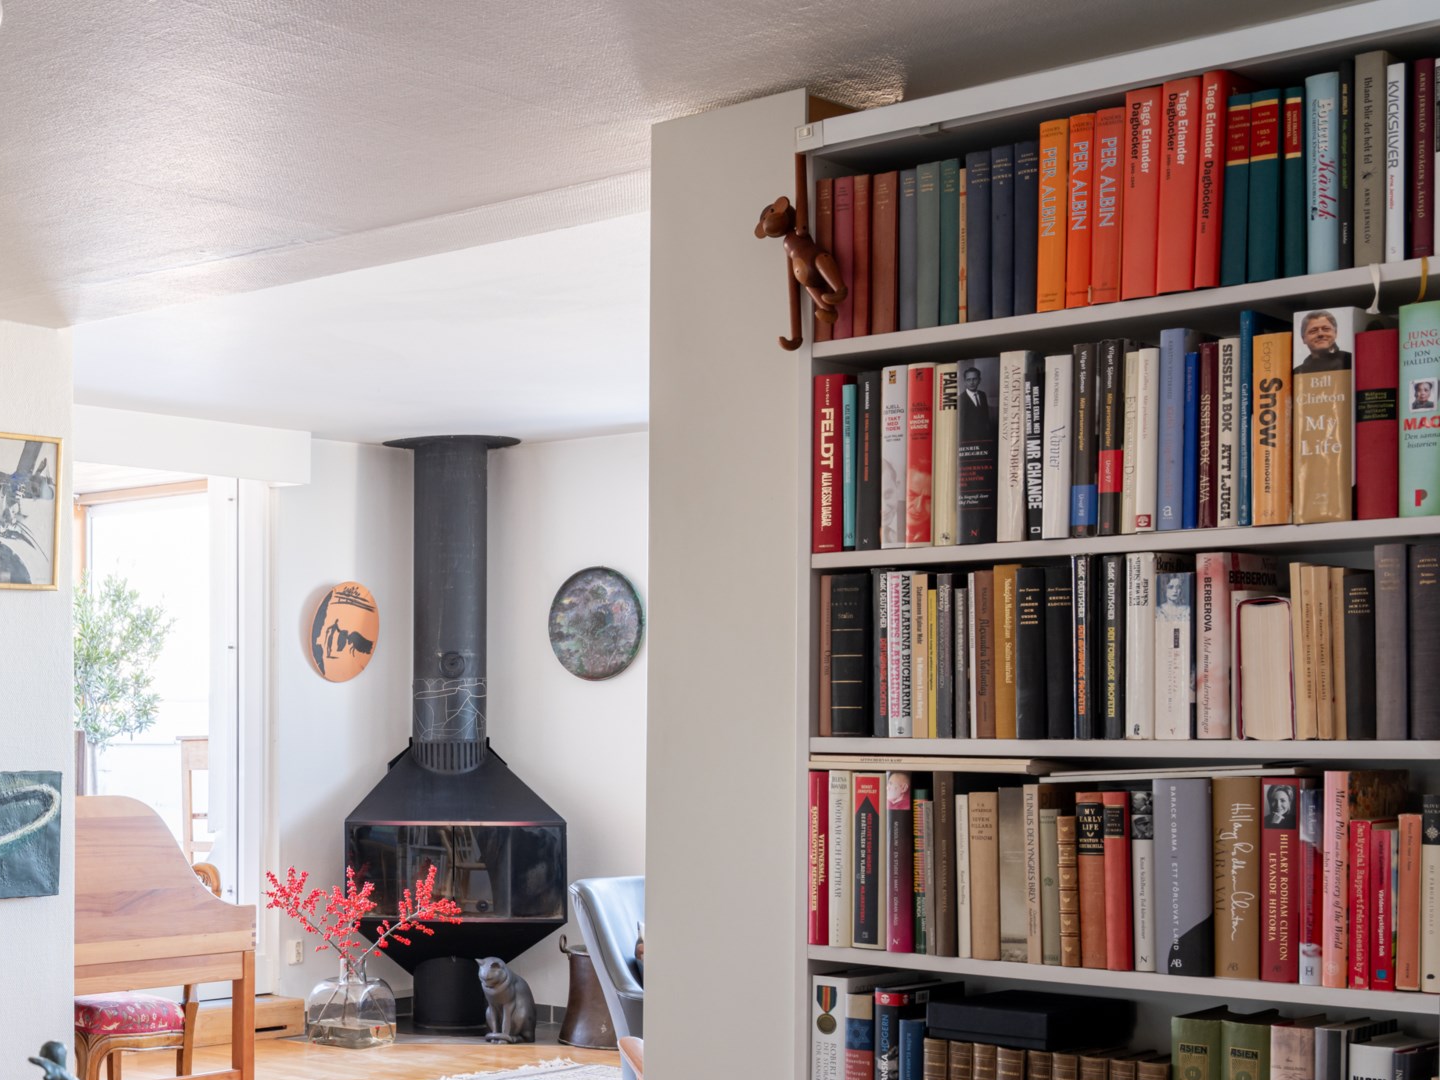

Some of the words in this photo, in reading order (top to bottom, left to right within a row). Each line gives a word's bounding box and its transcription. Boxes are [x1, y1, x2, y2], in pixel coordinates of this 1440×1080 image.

[1177, 91, 1189, 117] Tage
[1206, 84, 1217, 110] Tage
[1363, 78, 1373, 104] Ibland
[1129, 102, 1142, 160] Dagböcker
[1141, 100, 1153, 126] Tage
[1166, 93, 1179, 151] Dagböcker
[1363, 106, 1373, 120] blir
[1387, 81, 1399, 169] KVICKSILVER
[1101, 137, 1117, 171] PER
[1141, 128, 1152, 173] Erlander
[1176, 119, 1188, 165] Erlander
[1204, 113, 1216, 158] Erlander
[1042, 147, 1057, 181] PER
[1073, 141, 1089, 175] PER
[1072, 179, 1087, 230] ALBIN
[1099, 175, 1115, 227] ALBIN
[1201, 161, 1214, 219] Dagböcker
[1317, 155, 1337, 221] Kärlek
[1041, 185, 1056, 236] ALBIN
[1408, 329, 1438, 341] JUNG
[1078, 351, 1087, 370] Vilgot
[1106, 346, 1115, 365] Vilgot
[1221, 344, 1233, 400] SISSELA
[1262, 341, 1273, 373] Edgar
[942, 372, 958, 411] PALME
[1010, 364, 1020, 411] AUGUST
[1078, 371, 1086, 393] Sjöman
[1105, 366, 1114, 388] Sjöman
[1311, 375, 1331, 388] Bill
[1200, 394, 1210, 440] SISSELA
[1260, 377, 1283, 448] Snow
[1296, 392, 1345, 405] Clinton
[1221, 403, 1232, 433] BOK
[1305, 415, 1337, 439] My
[1403, 415, 1440, 431] MAO
[821, 408, 834, 468] FELDT
[1009, 412, 1020, 489] STRINDBERG
[1026, 440, 1042, 459] MR
[1049, 425, 1066, 471] Vänner
[1200, 441, 1210, 466] BOK
[1301, 439, 1342, 456] Life
[1220, 444, 1231, 472] ATT
[1263, 450, 1272, 494] memoarer
[1026, 462, 1042, 510] CHANCE
[1200, 475, 1209, 504] ALVA
[1220, 475, 1231, 521] LJUGA
[902, 575, 911, 606] ANNA
[1077, 580, 1085, 618] DEUTSCHER
[1107, 582, 1115, 620] DEUTSCHER
[1203, 577, 1212, 633] BERBEROVA
[891, 582, 900, 638] MINNETS
[902, 609, 910, 650] LARINA
[891, 642, 900, 718] LABYRINTER
[902, 654, 911, 718] BUCHARINA
[1201, 674, 1211, 734] understrykningar
[834, 799, 843, 835] MÖDRAR
[1025, 793, 1034, 825] PLINIUS
[1079, 815, 1103, 823] EARLY
[1220, 803, 1255, 840] Hillary
[1335, 788, 1345, 818] Marco
[1026, 828, 1035, 846] DEN
[1082, 823, 1099, 831] LIFE
[1334, 820, 1345, 840] Polo
[1026, 848, 1035, 882] YNGRES
[1279, 834, 1288, 874] HILLARY
[834, 860, 843, 897] DÖTTRAR
[1268, 853, 1276, 895] LEVANDE
[1333, 860, 1343, 899] Discovery
[1027, 882, 1036, 904] BREV
[1172, 881, 1180, 925] FÖRLOVAT
[1279, 877, 1288, 917] RODHAM
[1231, 891, 1255, 942] Clinton
[1268, 899, 1276, 942] HISTORIA
[1279, 921, 1288, 961] CLINTON
[1334, 926, 1343, 949] World
[1179, 1043, 1208, 1055] ASIEN
[1230, 1047, 1258, 1060] ASIEN
